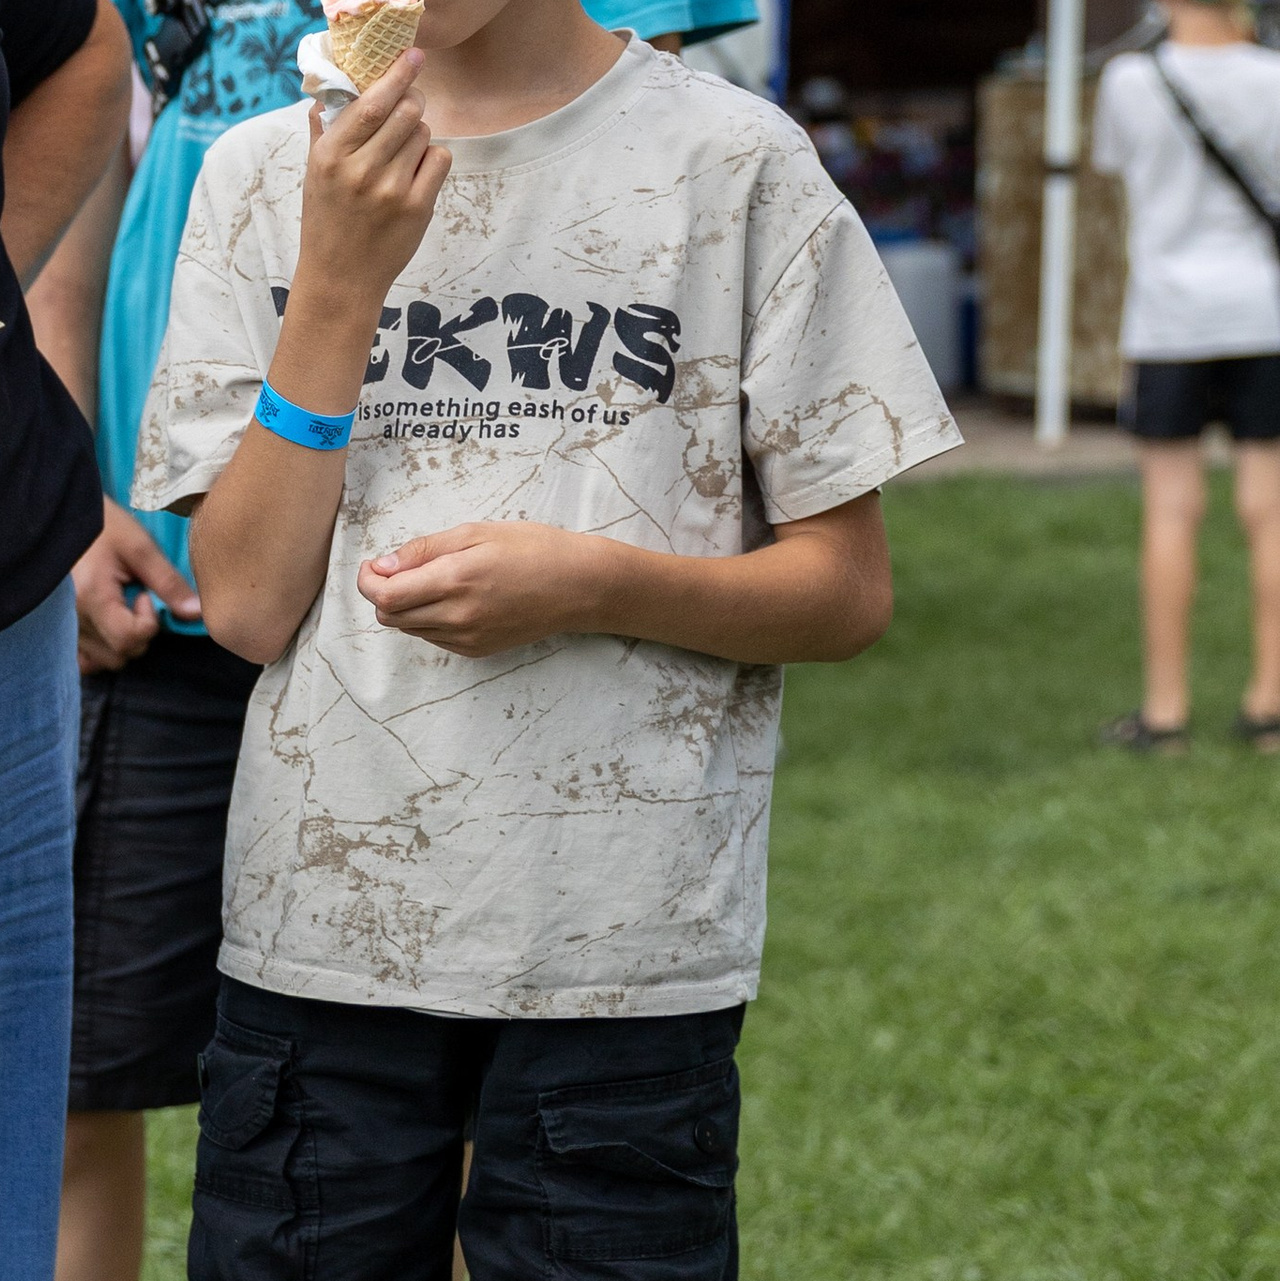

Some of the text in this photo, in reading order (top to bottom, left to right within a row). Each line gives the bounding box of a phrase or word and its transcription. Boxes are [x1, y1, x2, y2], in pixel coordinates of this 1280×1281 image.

[373, 397, 501, 421] something
[507, 398, 565, 421] eash
[570, 403, 598, 423] of
[602, 410, 631, 426] us
[383, 418, 520, 444] already has
